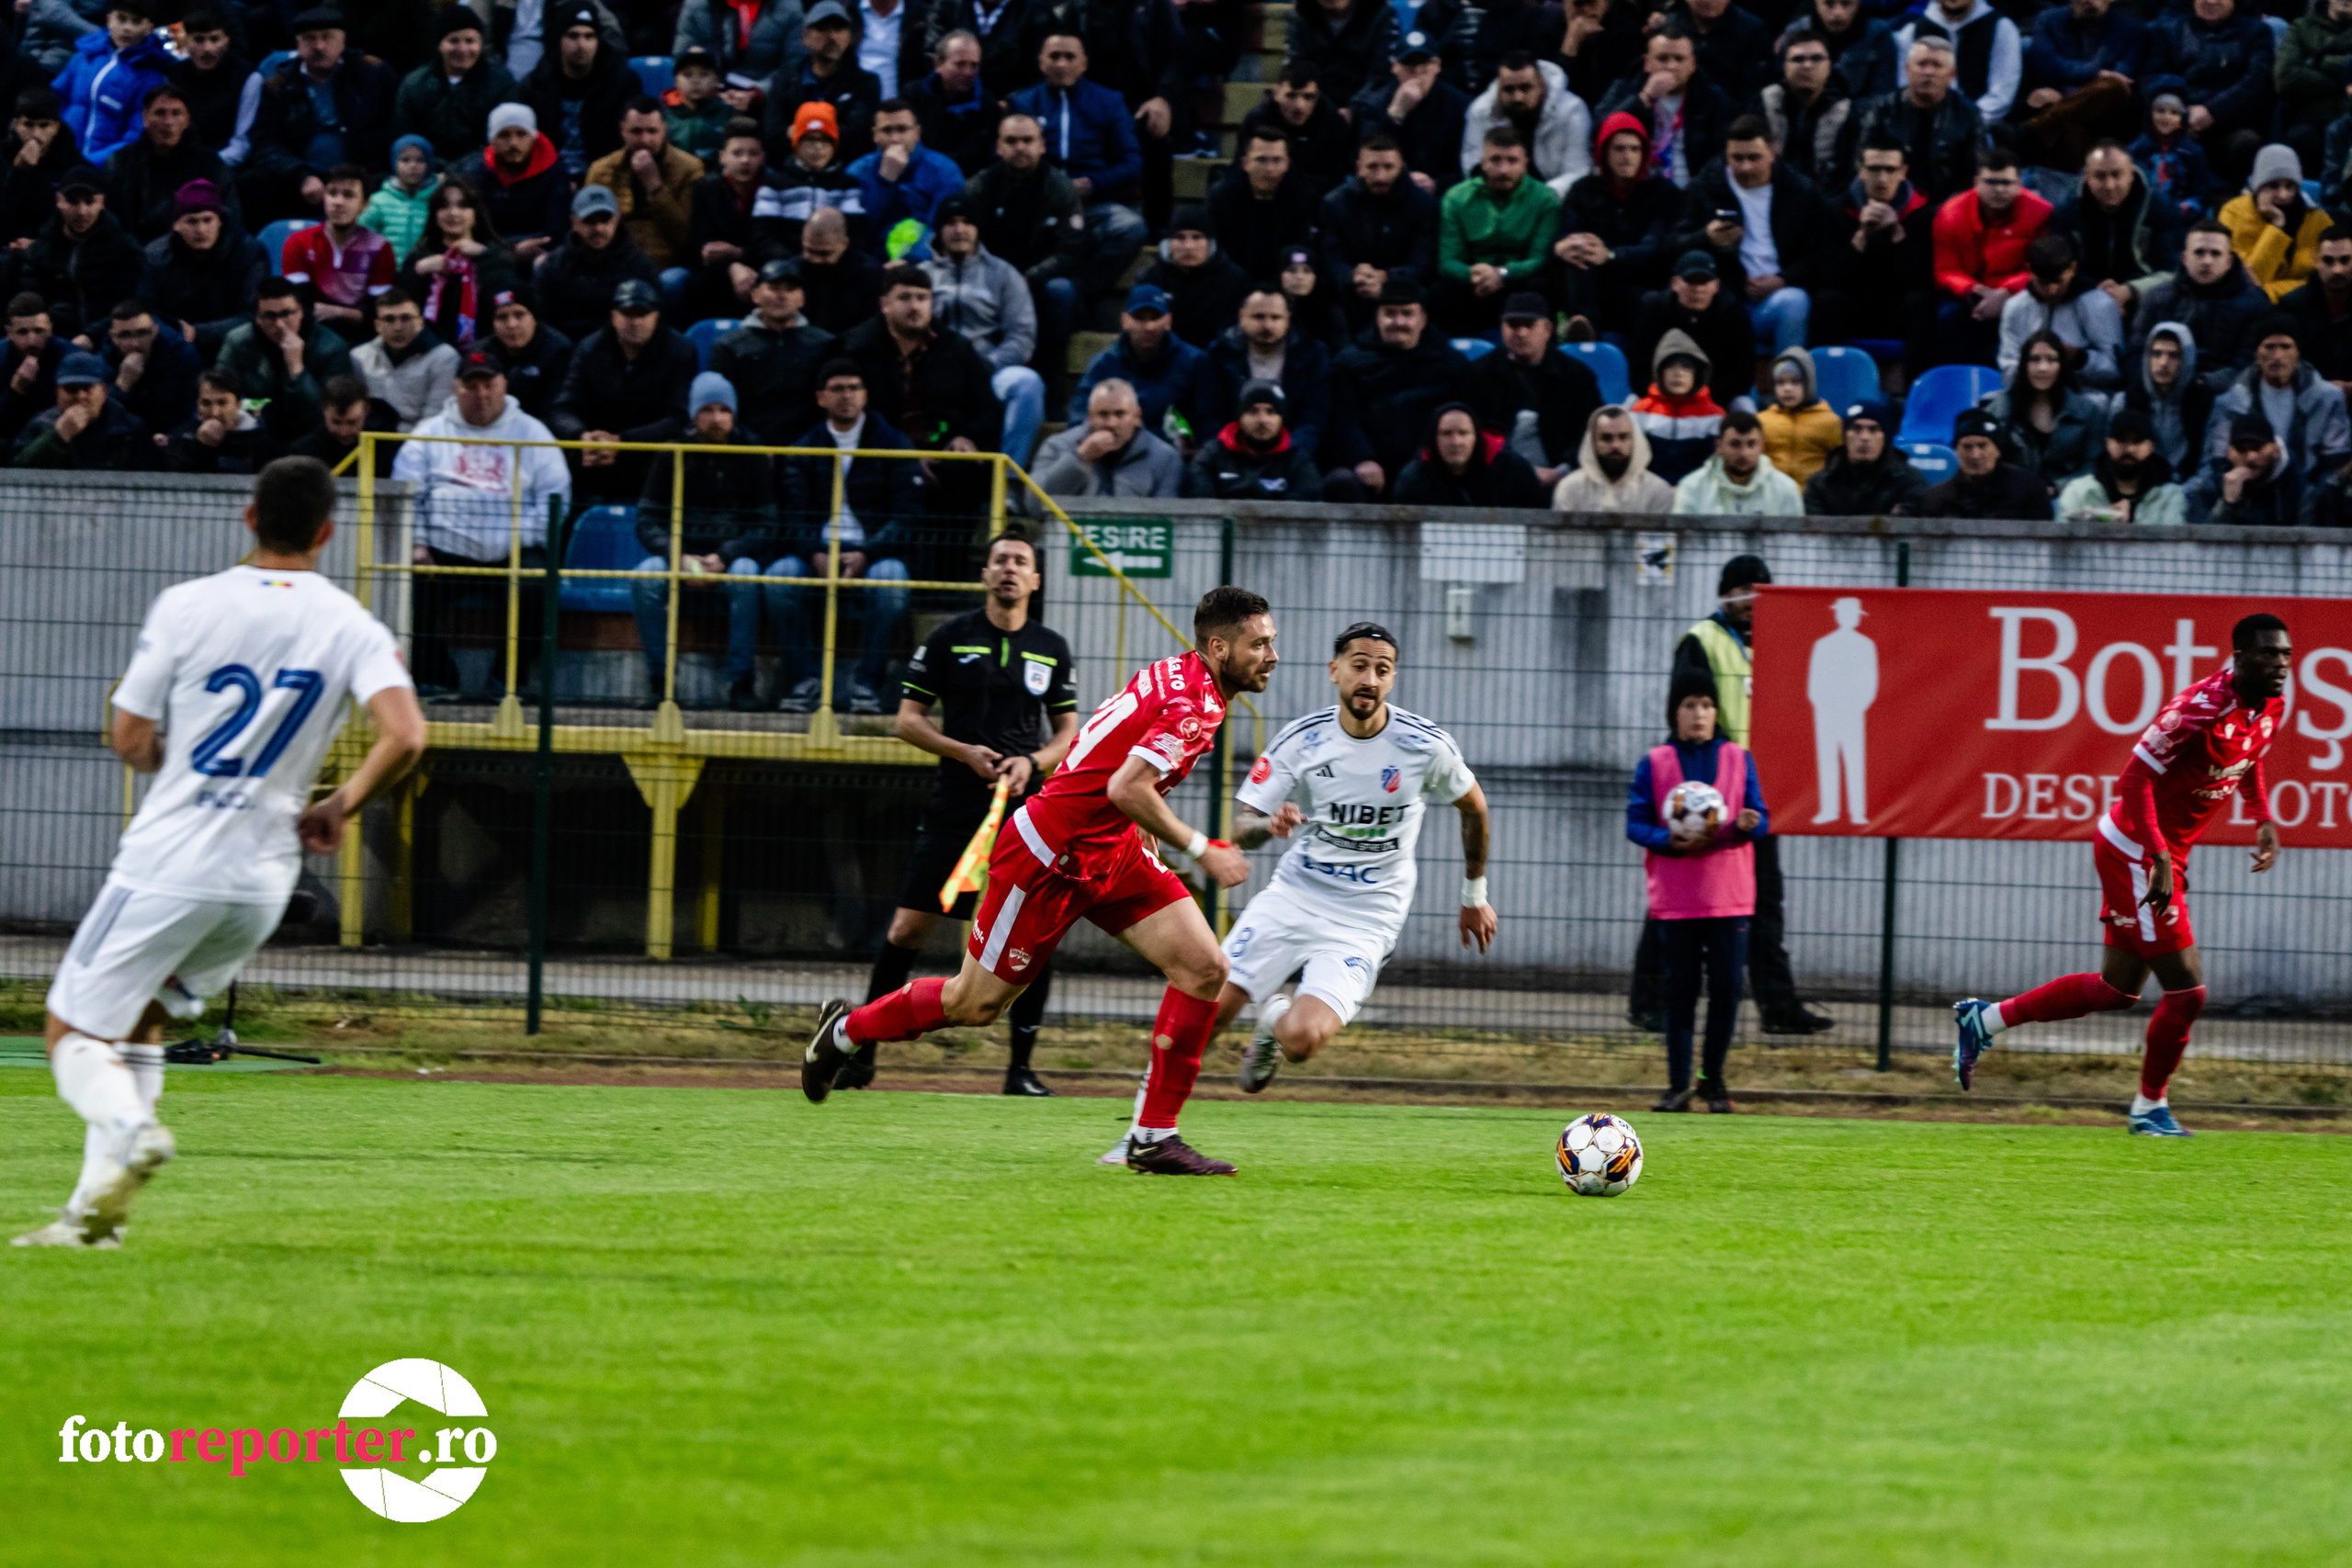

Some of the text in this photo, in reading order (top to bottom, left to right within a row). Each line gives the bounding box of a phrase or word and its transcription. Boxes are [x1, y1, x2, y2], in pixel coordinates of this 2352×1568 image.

[191, 663, 324, 777] 27
[1329, 802, 1411, 825] NIBET
[1229, 927, 1254, 958] 8
